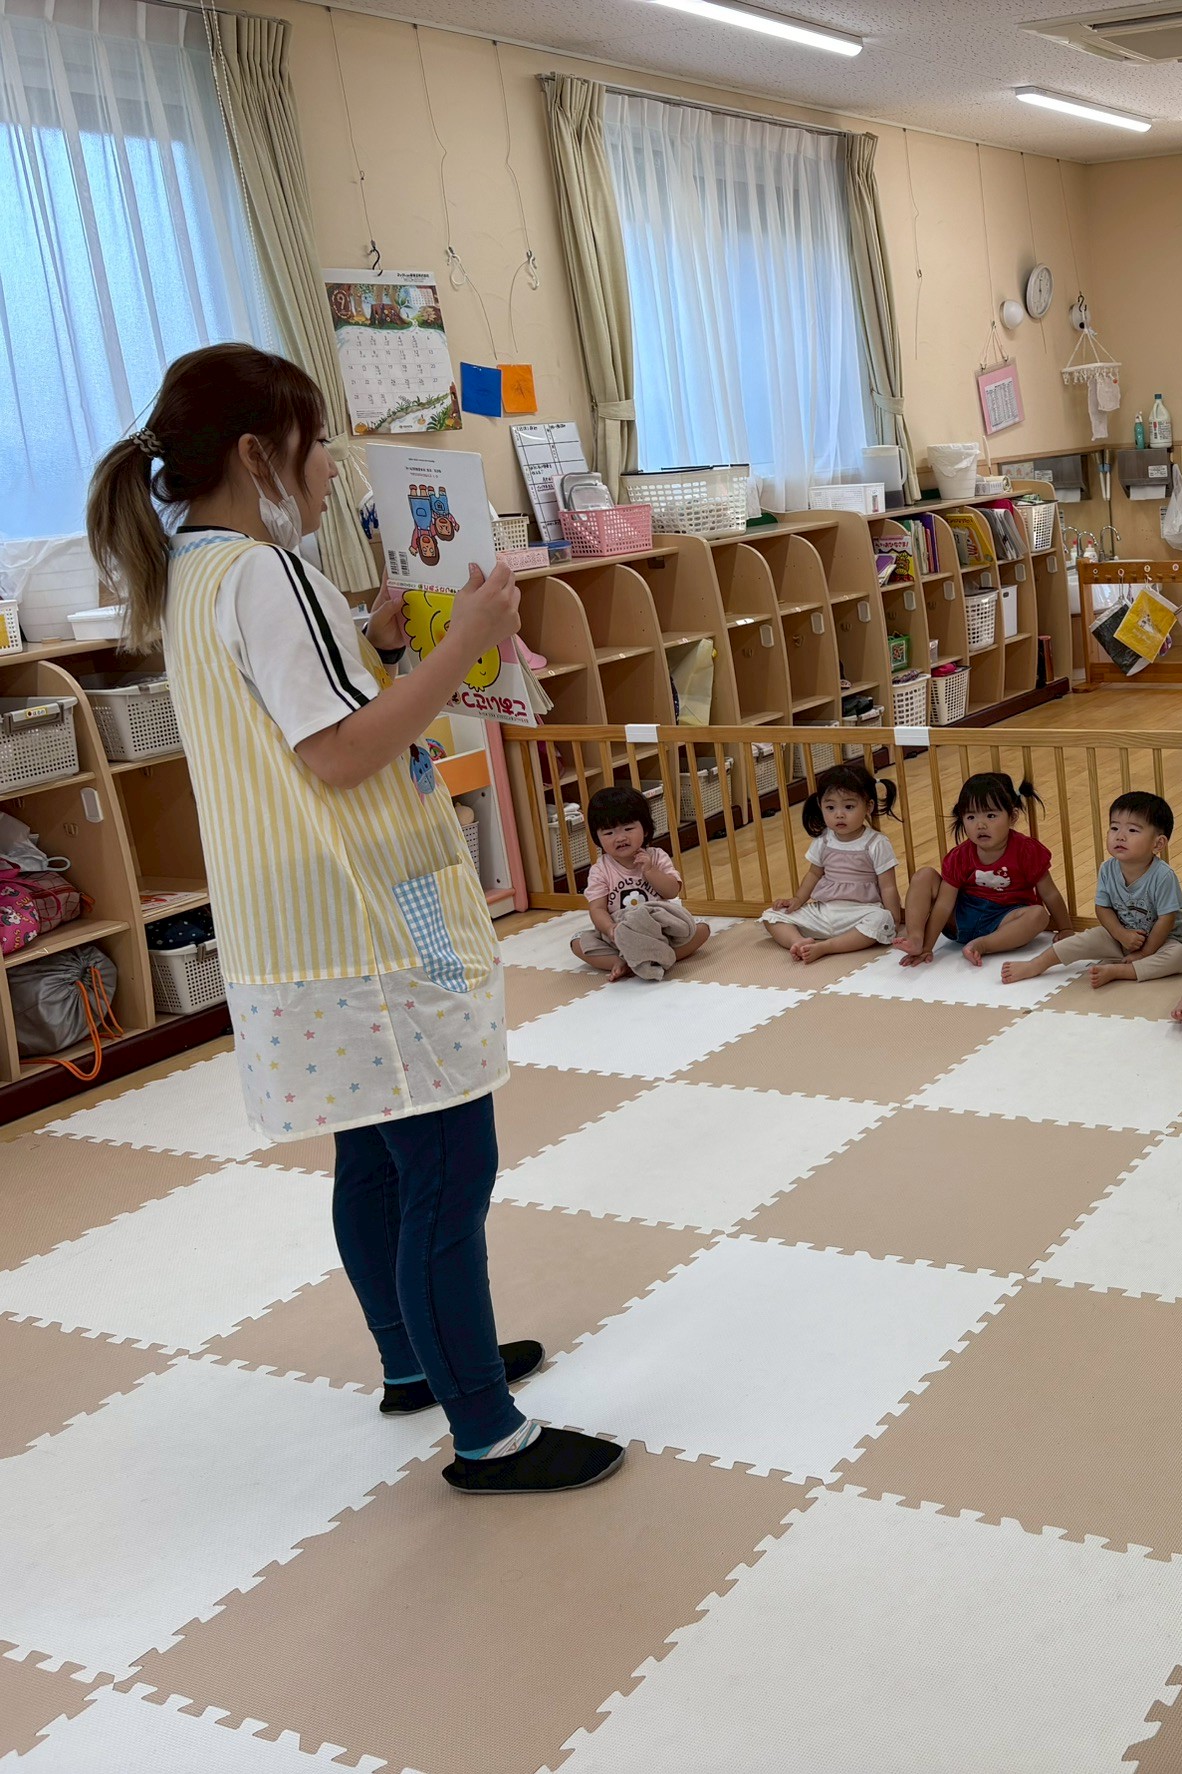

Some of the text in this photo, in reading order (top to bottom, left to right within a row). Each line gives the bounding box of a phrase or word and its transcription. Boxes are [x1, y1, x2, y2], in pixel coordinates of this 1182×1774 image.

[337, 294, 345, 310] 9
[461, 691, 527, 717] ごあいさつ
